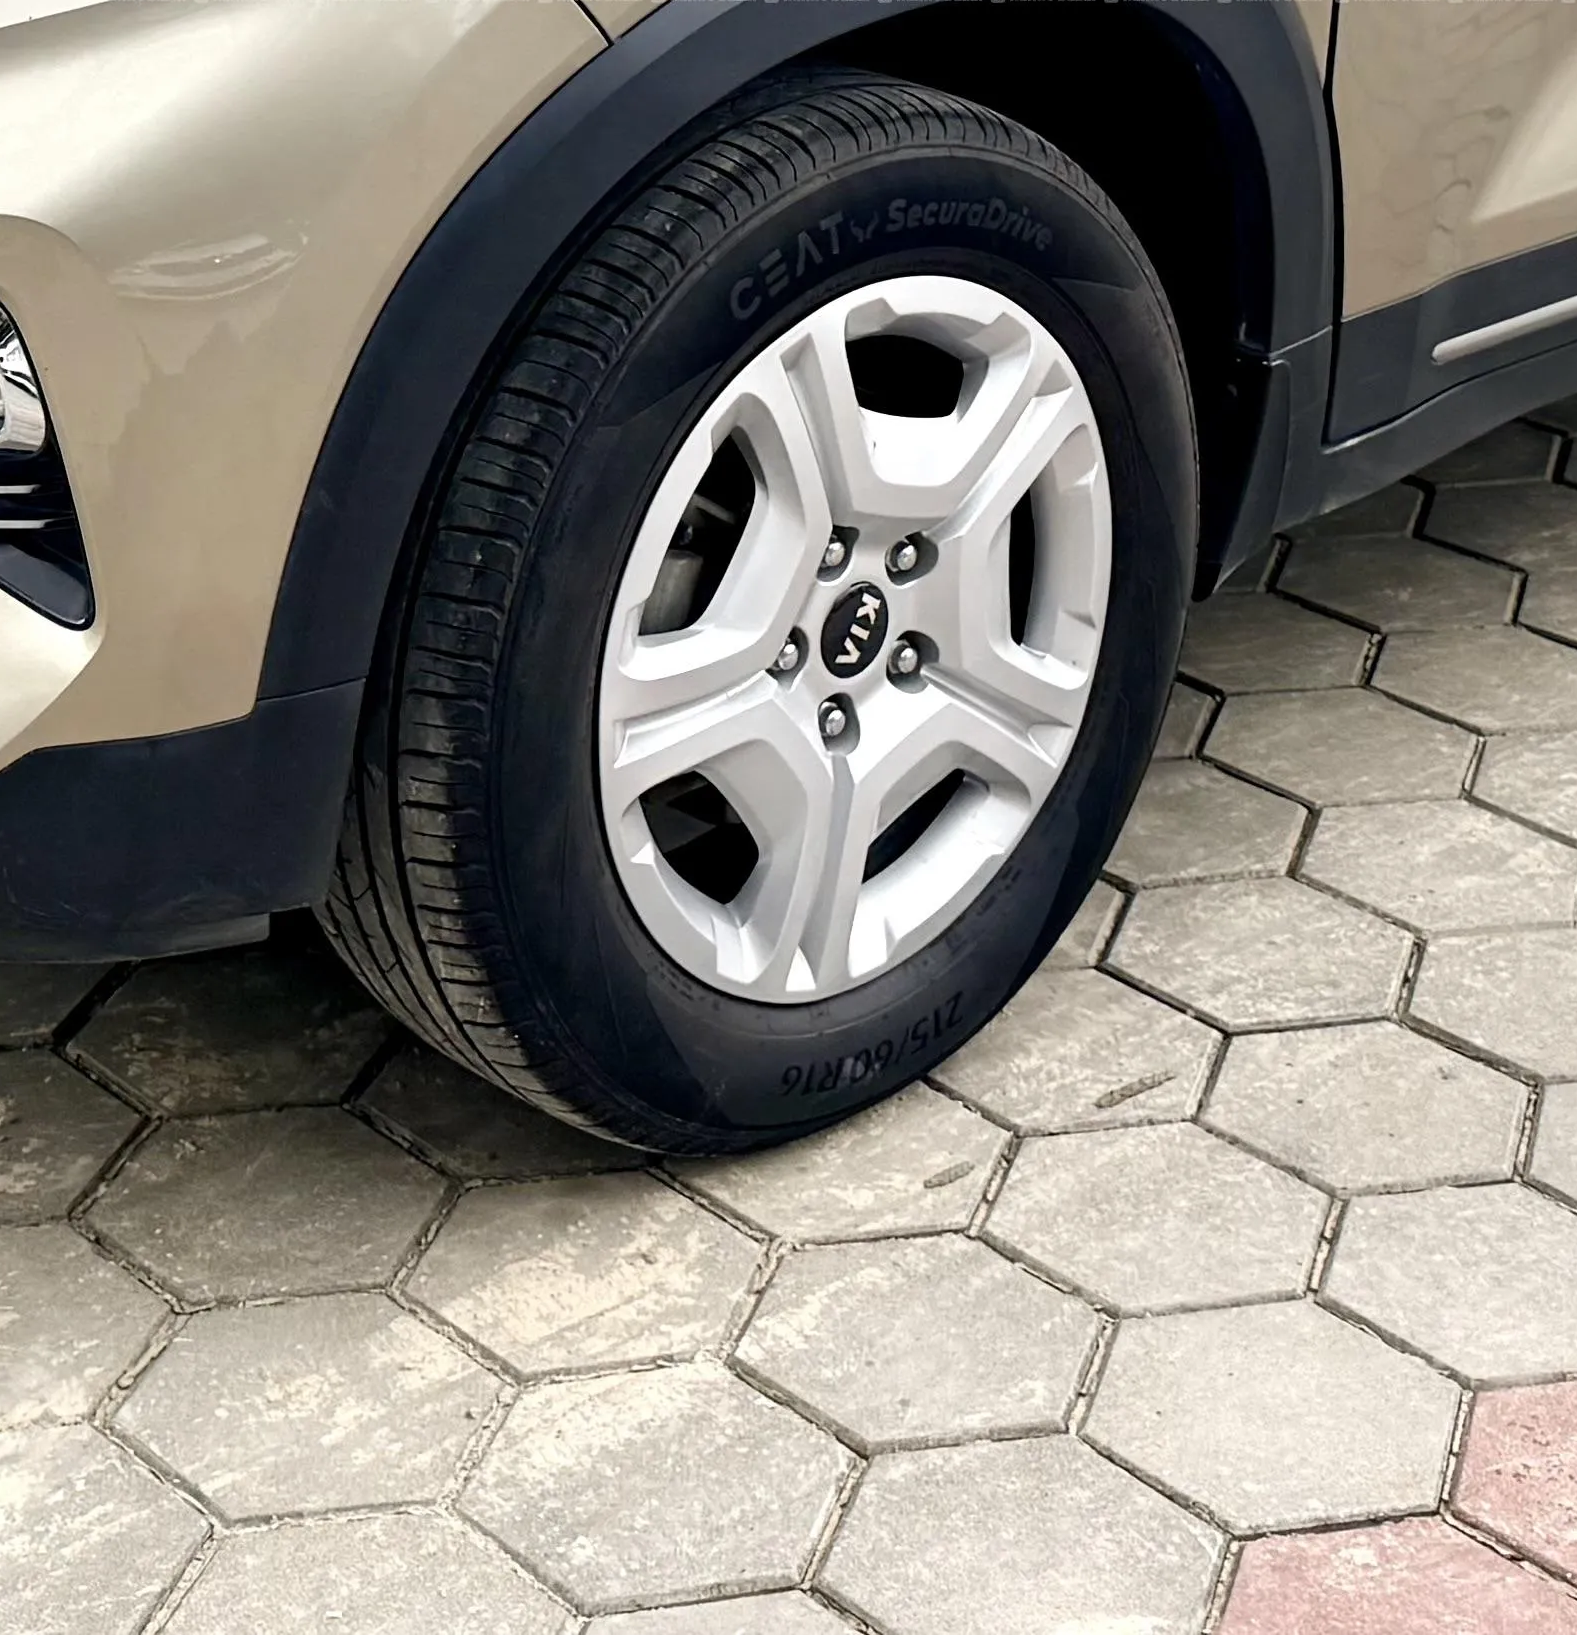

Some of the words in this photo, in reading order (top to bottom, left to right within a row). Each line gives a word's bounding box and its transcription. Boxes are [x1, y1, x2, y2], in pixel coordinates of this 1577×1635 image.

[728, 212, 845, 321] CEAT
[885, 197, 1054, 252] SecuraDrive
[834, 592, 882, 664] KIA
